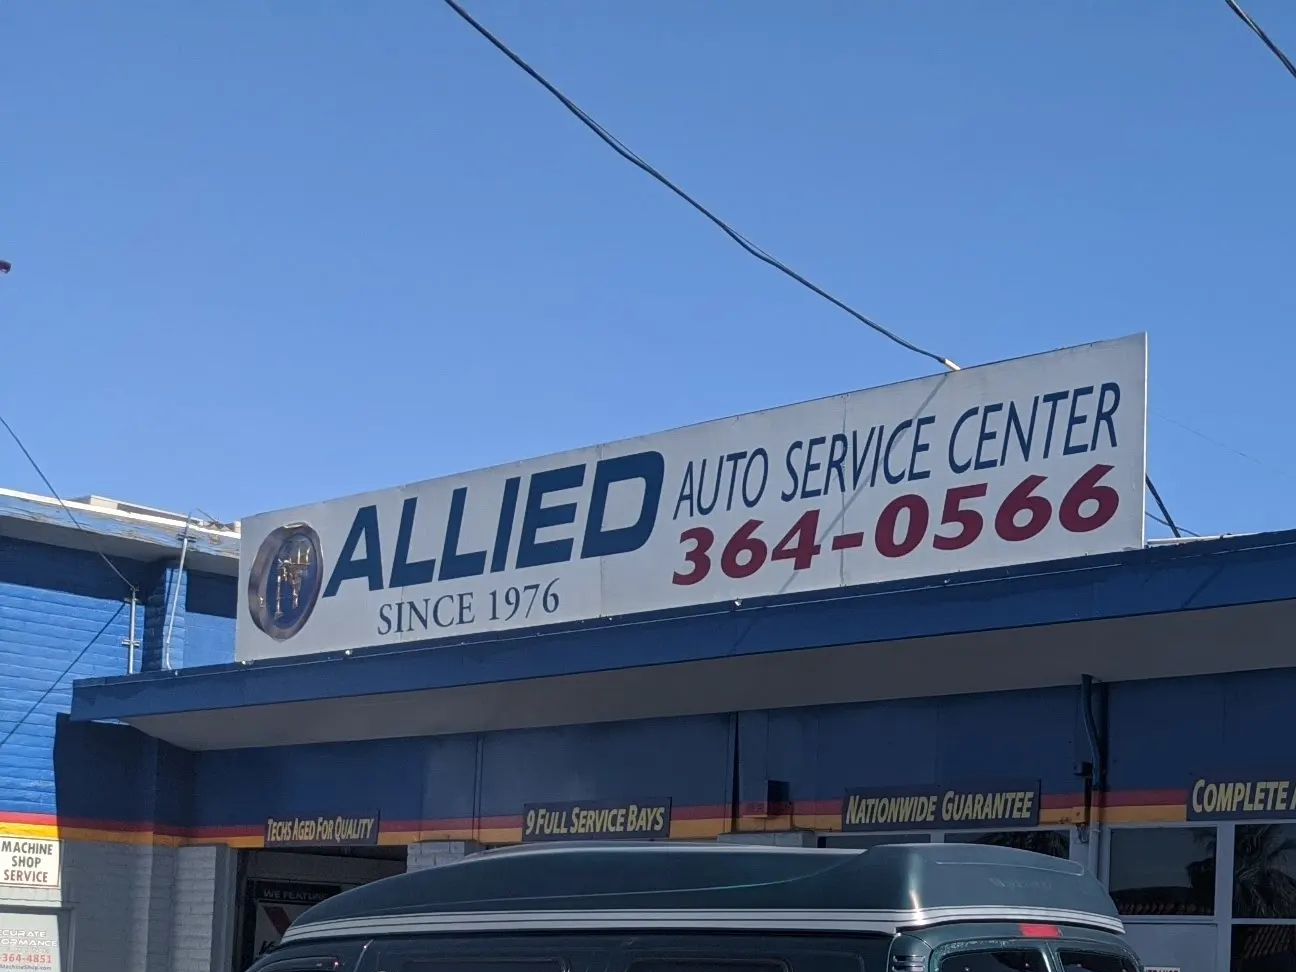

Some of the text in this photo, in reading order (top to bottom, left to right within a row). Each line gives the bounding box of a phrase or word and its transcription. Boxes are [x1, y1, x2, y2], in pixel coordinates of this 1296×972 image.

[673, 381, 1122, 521] AUTO SERVICE CENTER
[321, 449, 666, 599] ALLIED
[672, 462, 1122, 587] 364-0566
[377, 577, 560, 637] SINCE 1976
[846, 791, 1034, 825] NATIONWIDE GUARANTEE
[1192, 779, 1290, 813] COMPLETE
[267, 818, 293, 841] TECHS
[315, 817, 335, 840] FOR
[334, 816, 374, 843] QUALITY
[525, 804, 665, 836] 9 FULL SERVICE BAYS
[1, 840, 53, 856] MACHINE
[11, 855, 42, 868] SHOP
[3, 869, 48, 883] SERVICE
[0, 929, 46, 938] CURATE
